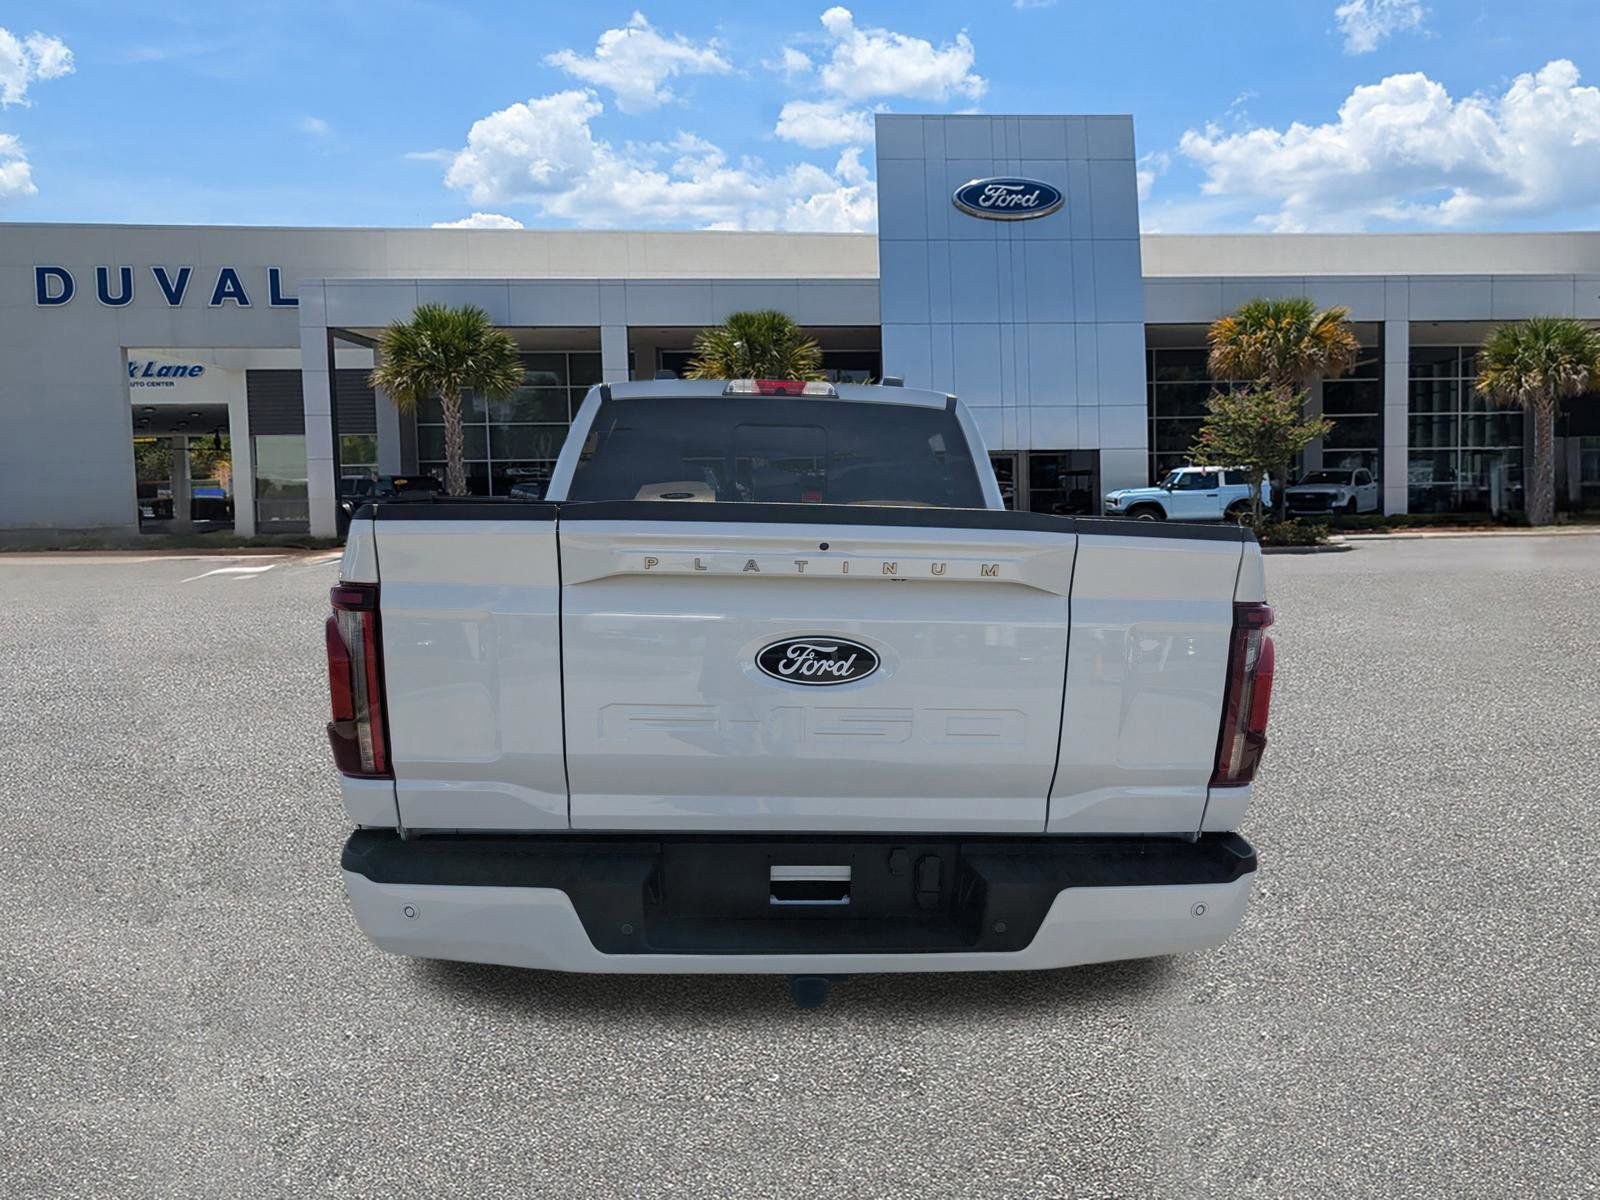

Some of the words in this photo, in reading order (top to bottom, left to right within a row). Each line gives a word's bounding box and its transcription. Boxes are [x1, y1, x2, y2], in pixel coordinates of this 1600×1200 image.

[979, 184, 1040, 207] Ford
[34, 265, 299, 307] DUVAL
[141, 361, 205, 378] Lane
[644, 556, 1000, 577] PLATINUM
[778, 643, 857, 677] Ford
